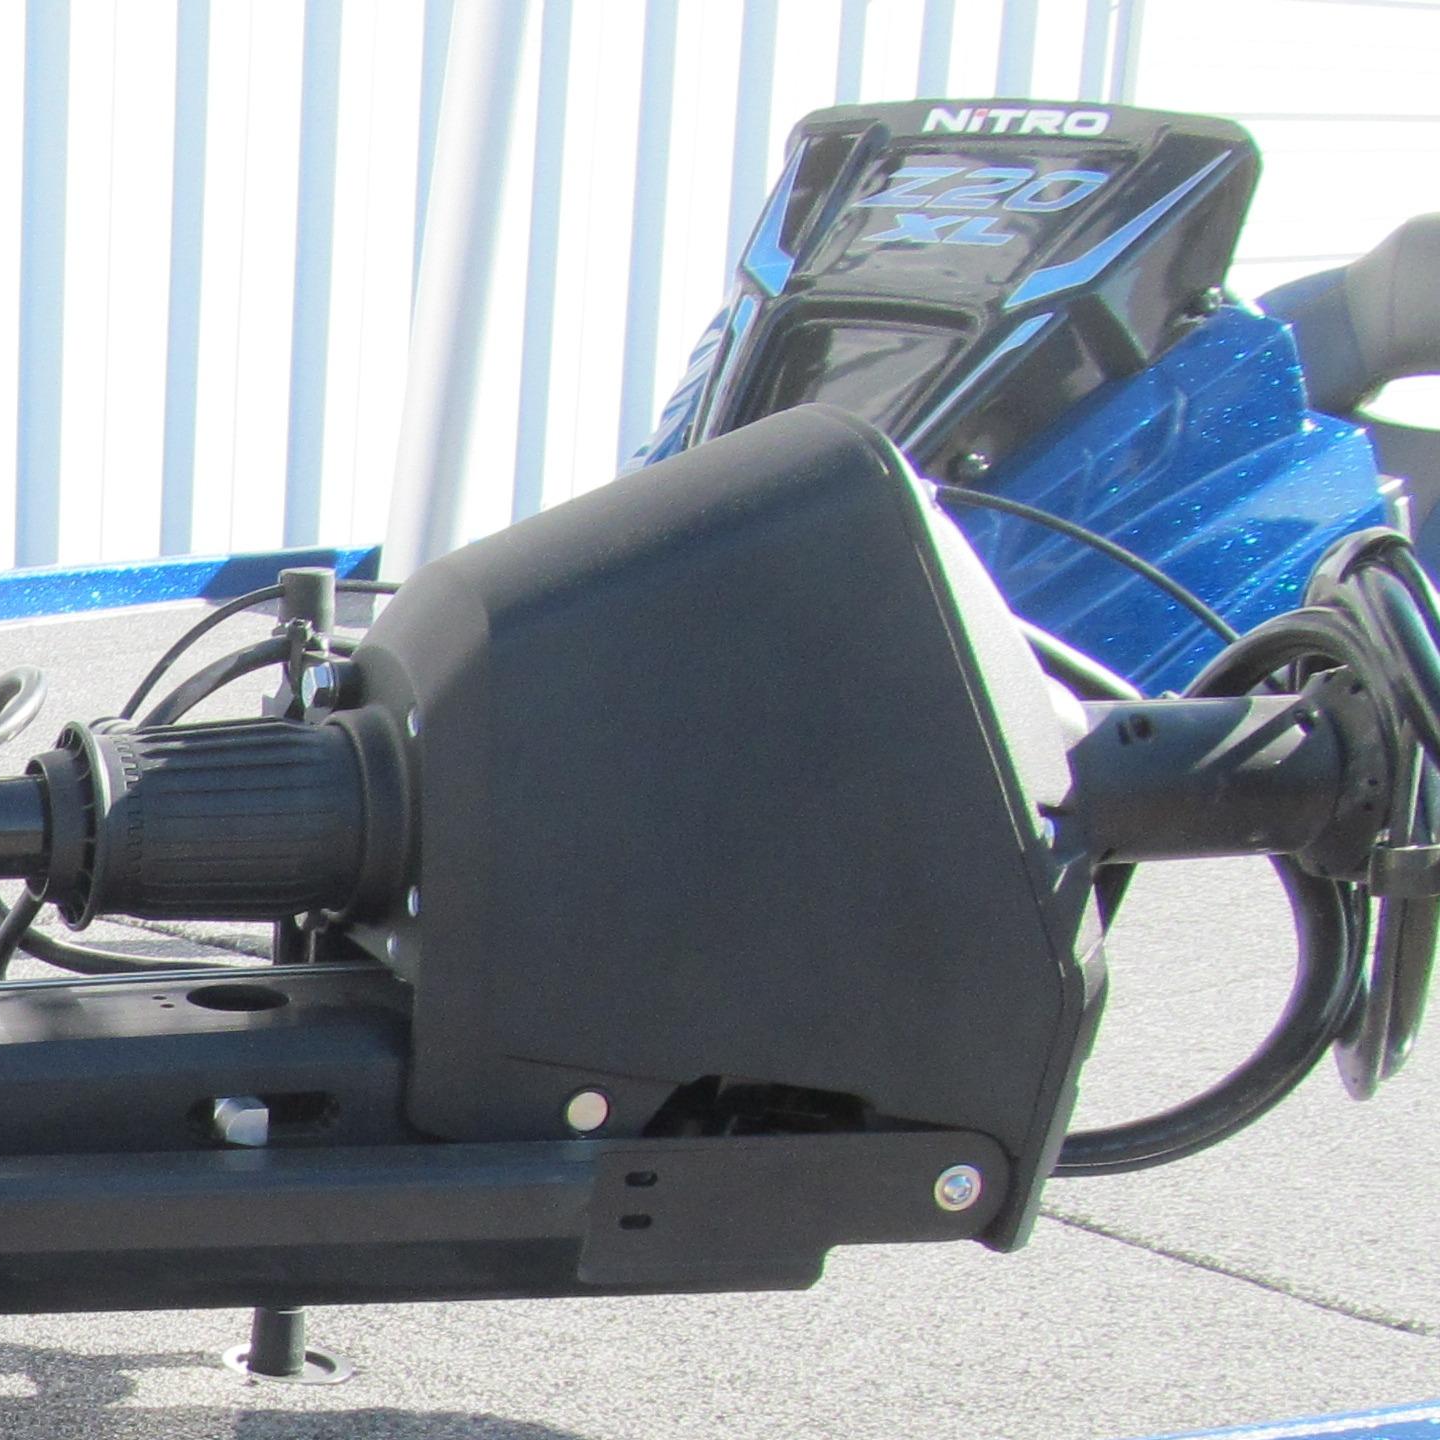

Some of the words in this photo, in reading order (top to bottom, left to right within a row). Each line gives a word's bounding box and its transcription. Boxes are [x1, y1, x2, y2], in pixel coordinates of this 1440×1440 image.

[922, 106, 1111, 137] NITRO
[855, 166, 1111, 213] Z20
[862, 213, 1015, 246] XL
